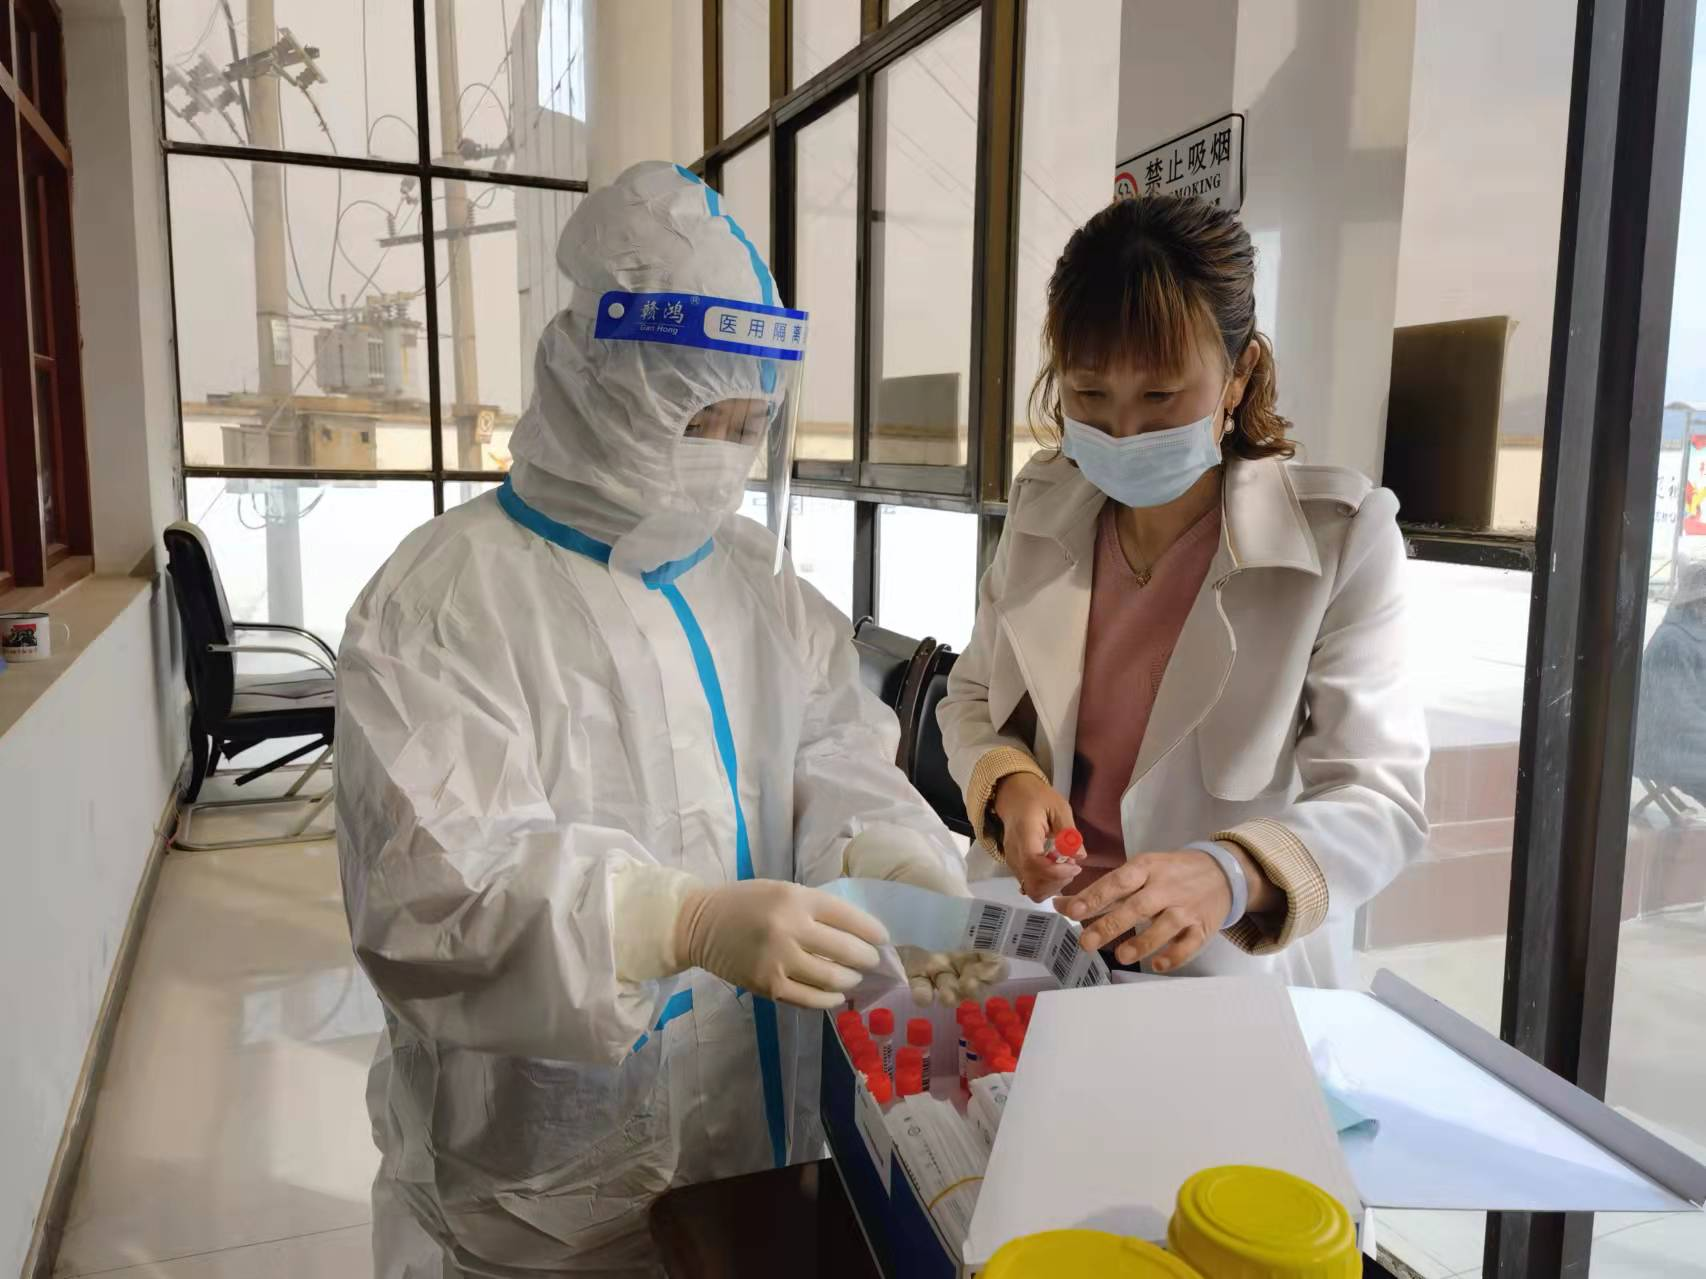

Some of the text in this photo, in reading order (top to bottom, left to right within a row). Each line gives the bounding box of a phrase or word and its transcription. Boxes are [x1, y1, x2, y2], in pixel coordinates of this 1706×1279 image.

[1145, 128, 1231, 194] 禁止吸烟
[1170, 173, 1221, 200] MOKING
[657, 325, 679, 336] Hong
